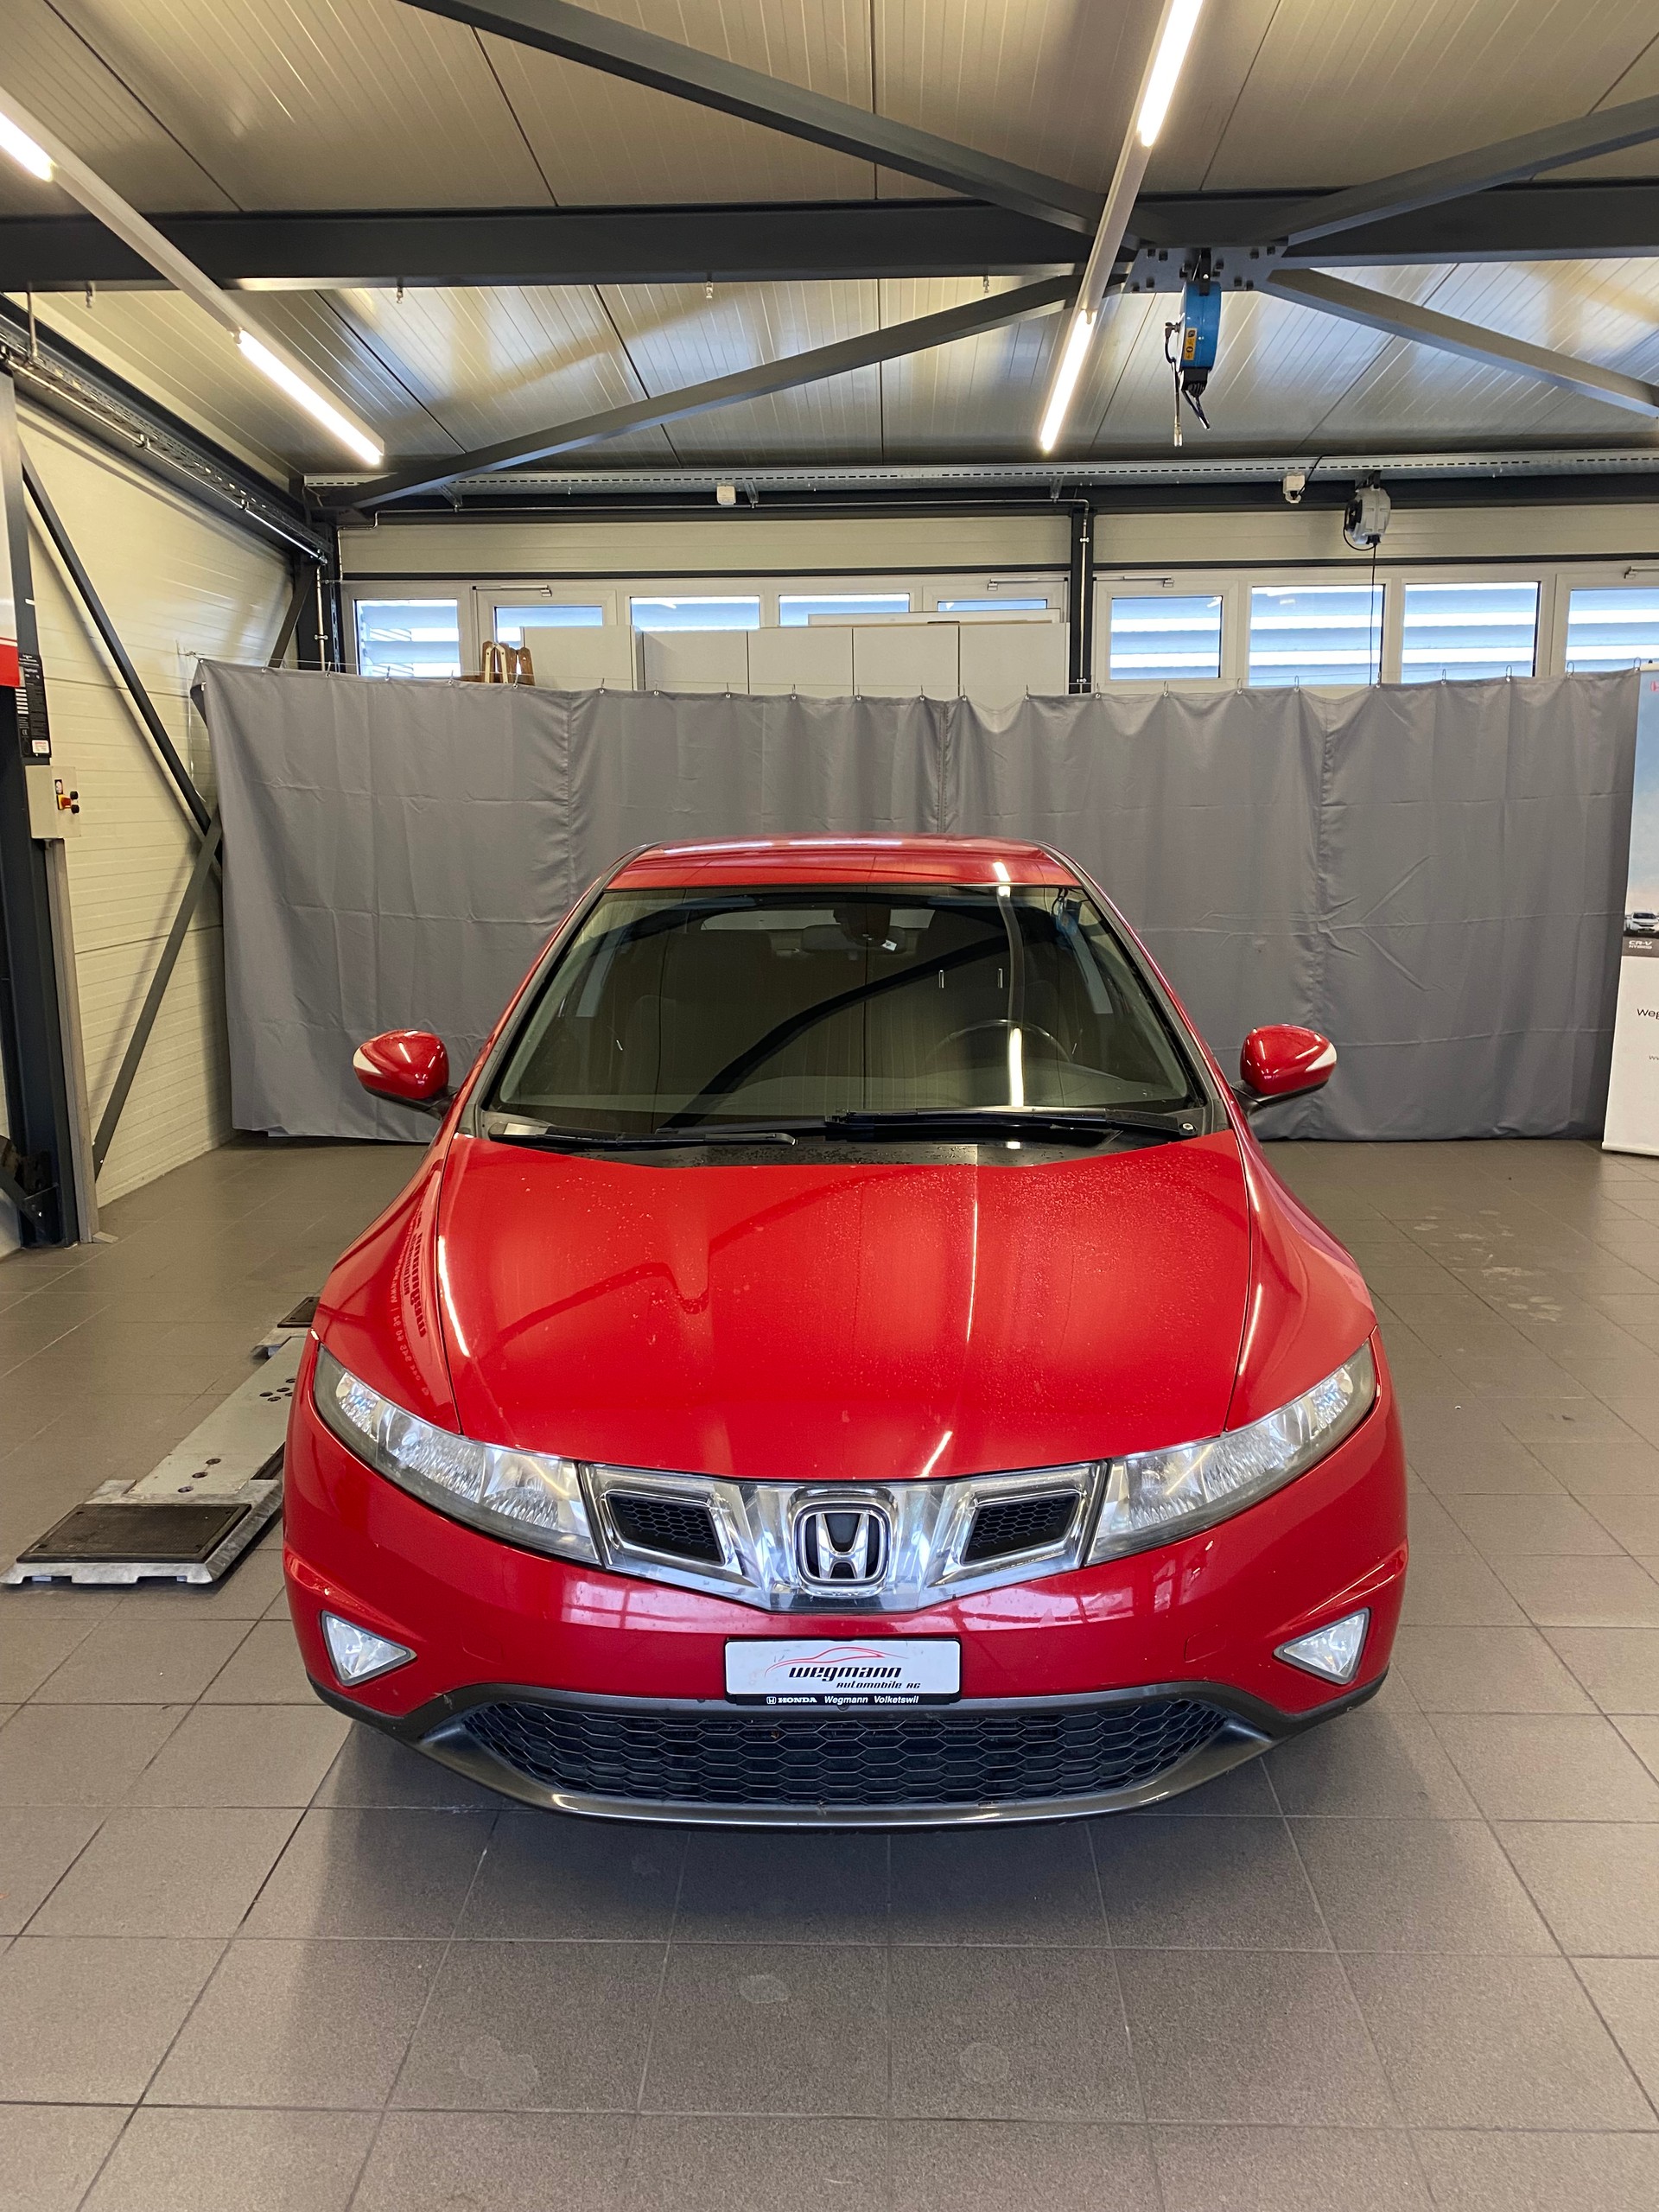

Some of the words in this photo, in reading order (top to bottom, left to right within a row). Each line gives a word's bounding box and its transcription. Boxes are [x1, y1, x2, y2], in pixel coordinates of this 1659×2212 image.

[788, 1666, 902, 1681] wegmann
[824, 1695, 868, 1705] Wegmann
[874, 1695, 919, 1704] Volketswil
